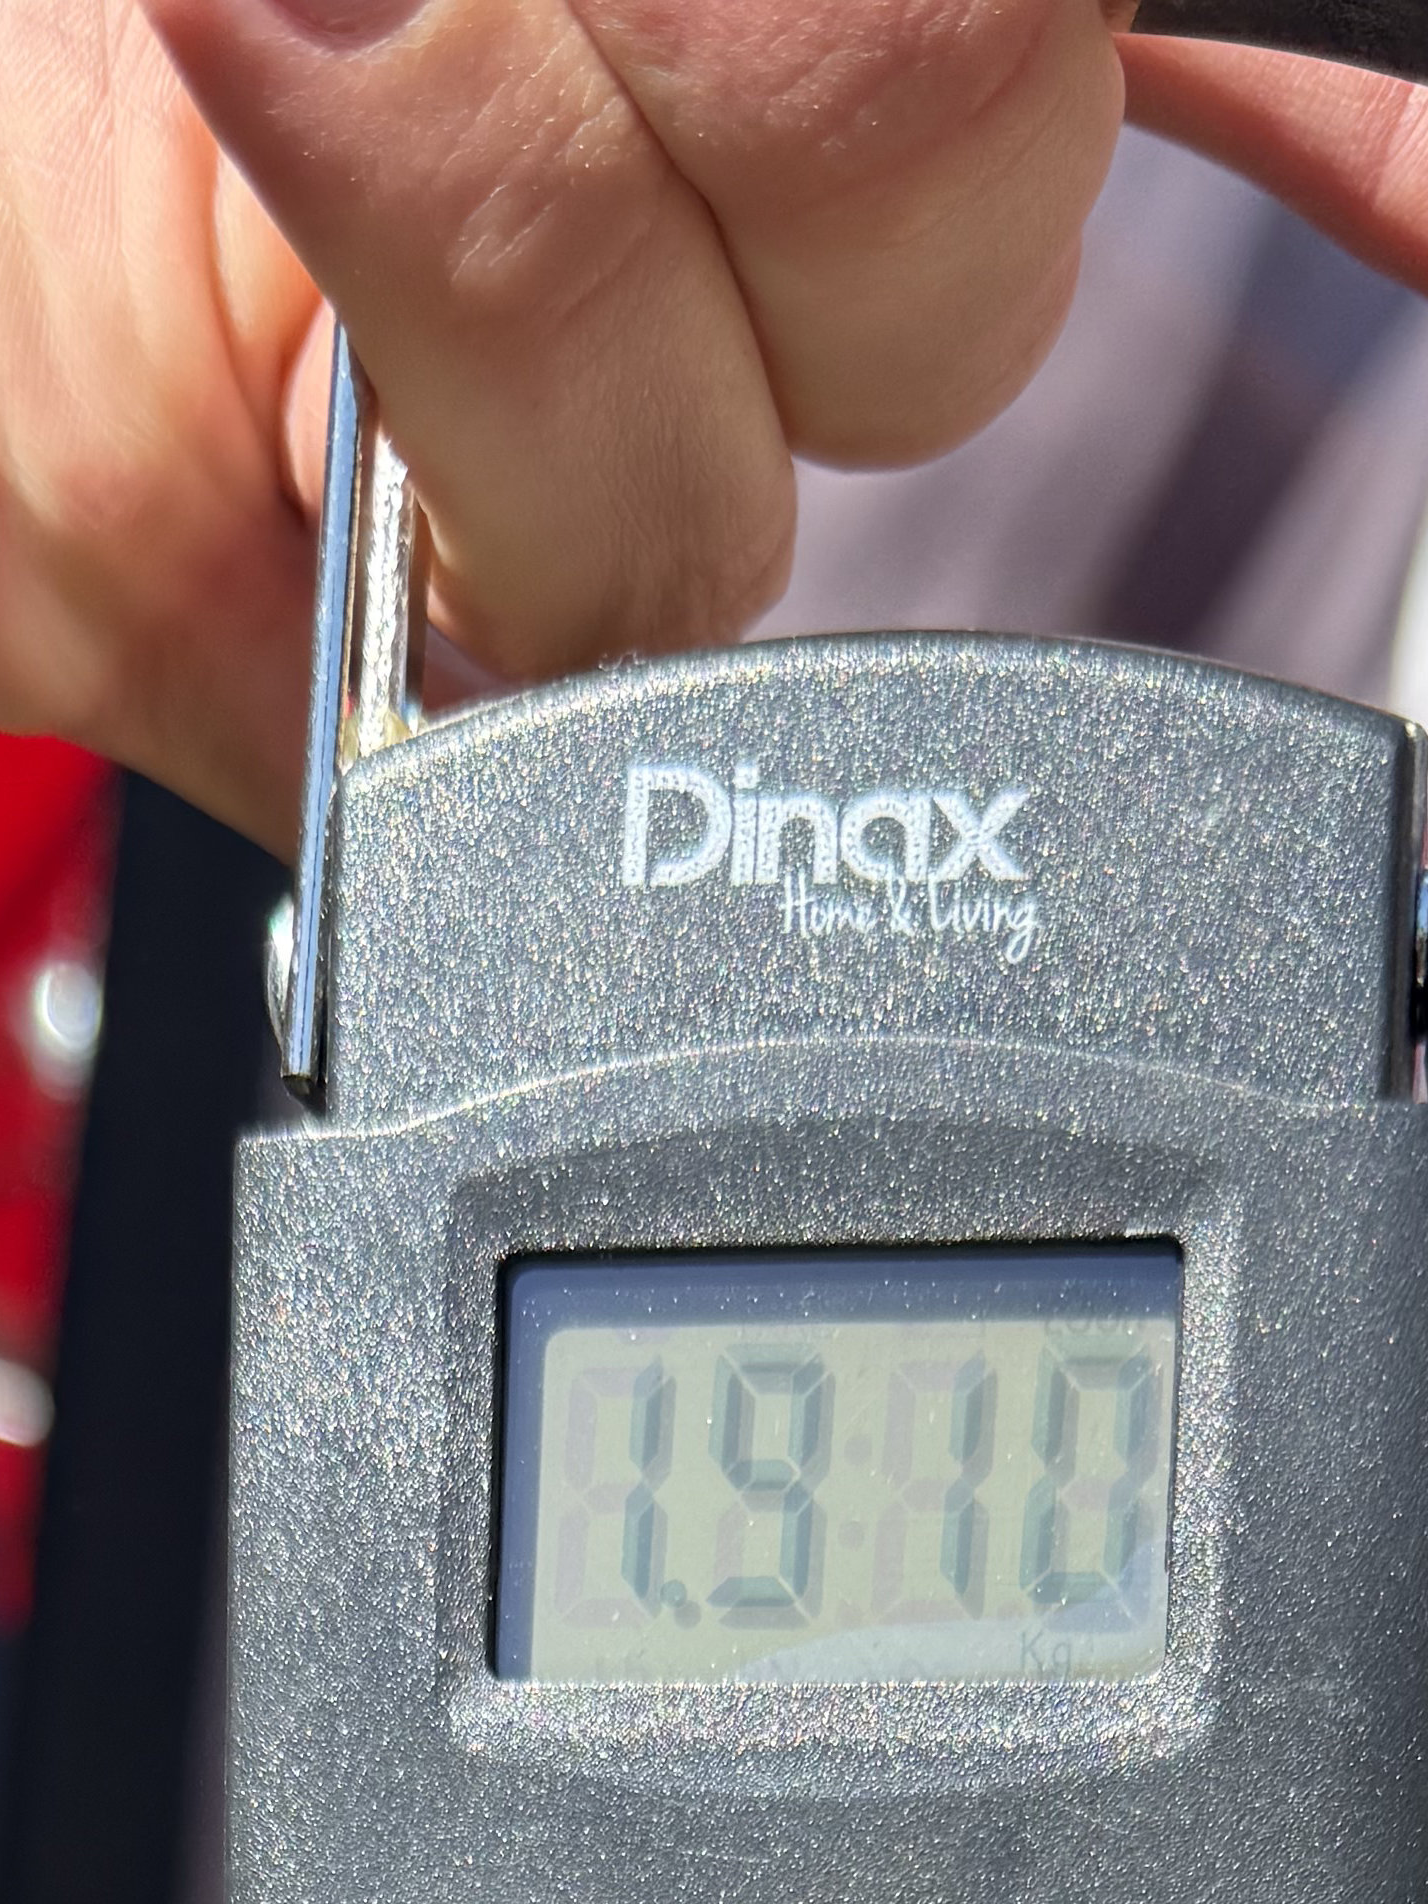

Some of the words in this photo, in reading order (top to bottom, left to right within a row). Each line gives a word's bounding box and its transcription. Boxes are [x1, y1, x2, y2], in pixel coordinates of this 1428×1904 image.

[623, 765, 1031, 888] Dinax
[783, 871, 878, 938] Home
[886, 868, 914, 938] &
[927, 877, 1041, 964] Living
[621, 1340, 1158, 1612] 1.910
